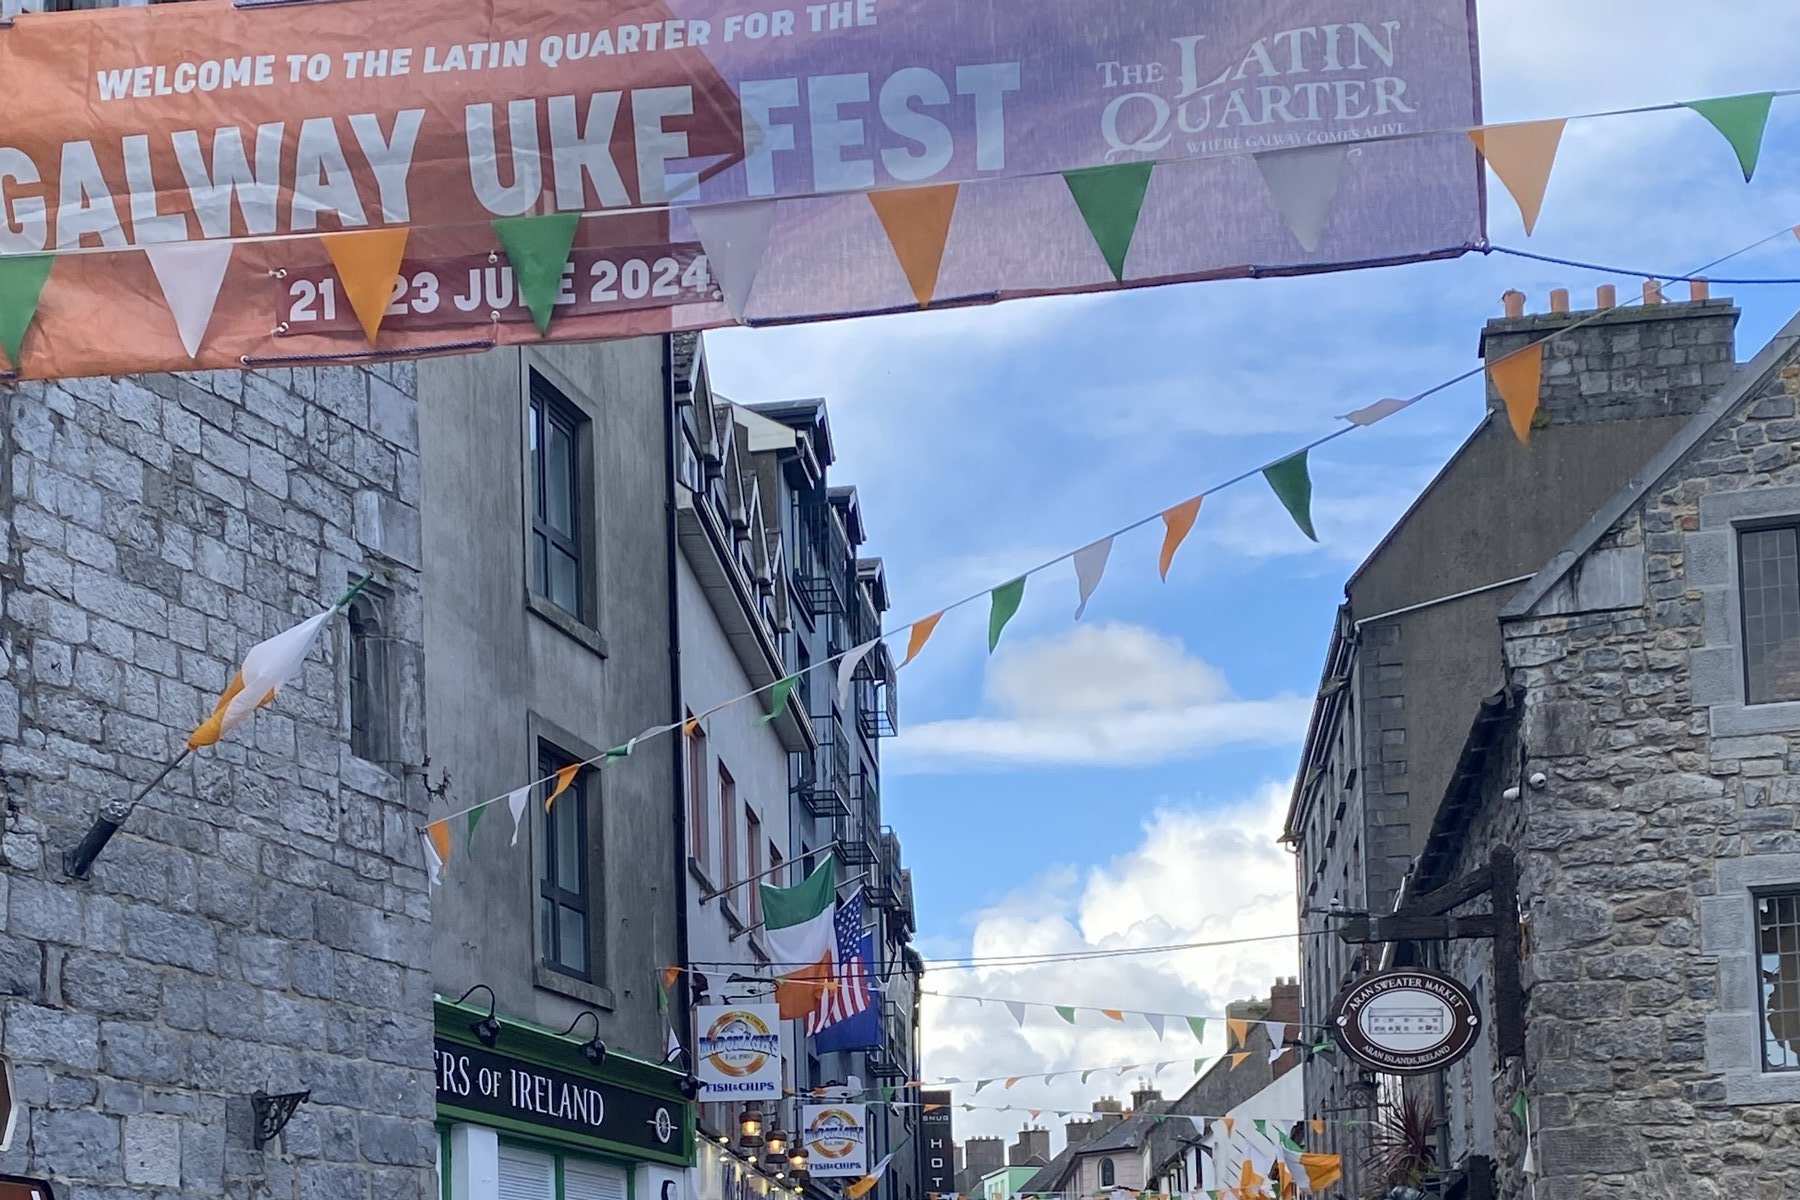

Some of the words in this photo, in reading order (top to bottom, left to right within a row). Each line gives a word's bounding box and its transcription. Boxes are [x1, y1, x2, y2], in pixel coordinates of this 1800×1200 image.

[97, 54, 275, 100] WELCOME
[286, 52, 331, 82] TO
[343, 47, 410, 79] THE
[423, 38, 528, 74] LATIN
[538, 19, 711, 69] QUARTER
[723, 10, 795, 44] FOR
[810, 1, 878, 32] THE
[1096, 61, 1164, 88] THE
[1170, 20, 1401, 98] LATIN
[1101, 76, 1420, 163] QUARTER
[1187, 139, 1242, 154] WHERE
[1246, 132, 1304, 149] GALWAY
[1306, 128, 1361, 144] COMES
[1365, 122, 1406, 138] ALIVE
[0, 108, 425, 254] GALWAY
[465, 86, 700, 216] UKE
[740, 62, 1020, 197] FEST
[289, 278, 336, 322] 21
[454, 262, 576, 312] JUE
[590, 255, 711, 303] 2024
[1349, 987, 1374, 1011] ARAN
[1374, 977, 1422, 992] SWEATER
[1425, 980, 1464, 1008] MARKET
[1362, 1044, 1384, 1060] ARAN
[510, 1069, 604, 1126] IRELAND
